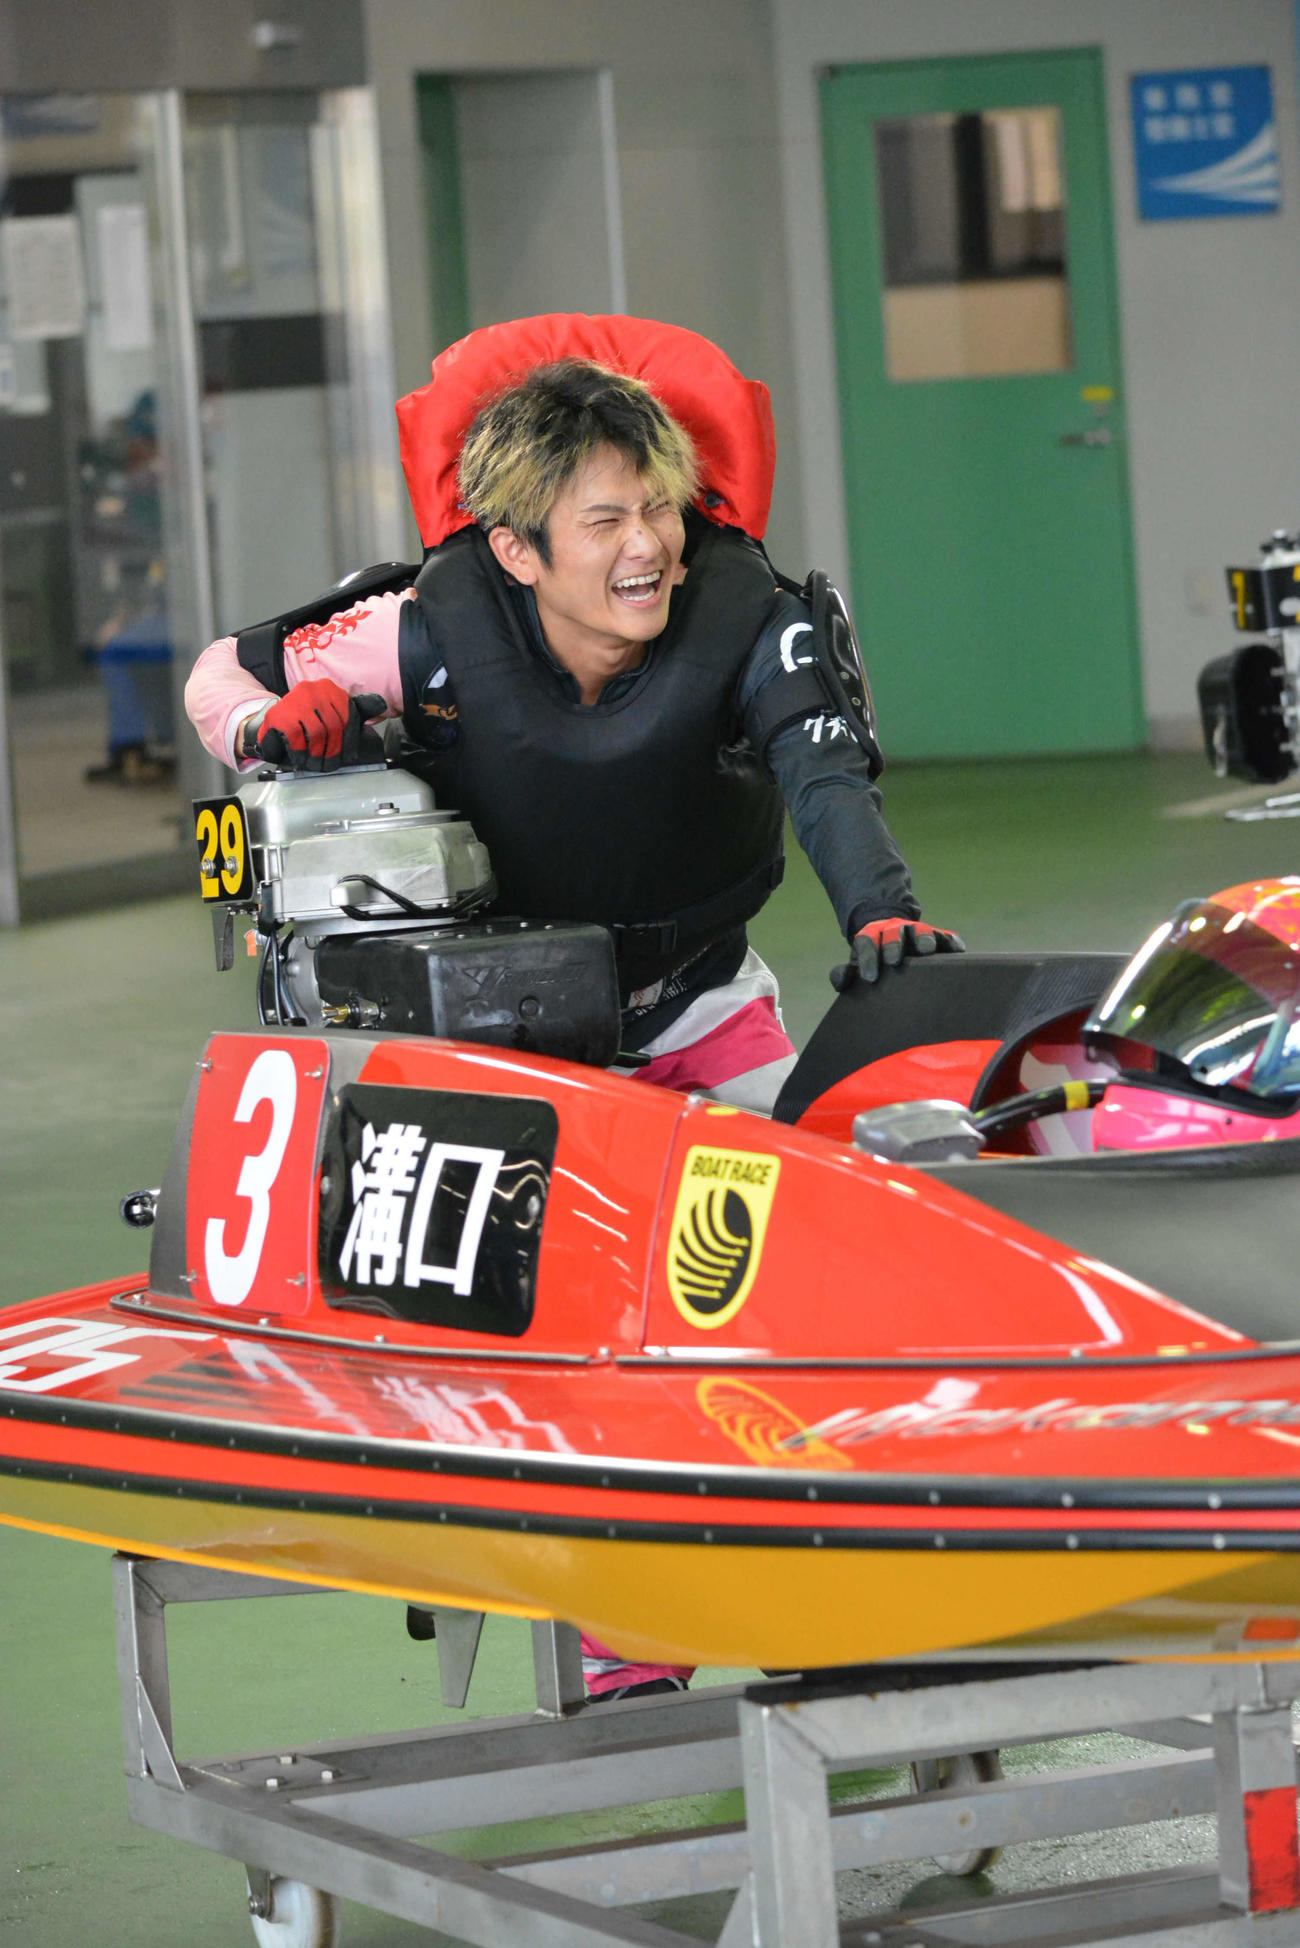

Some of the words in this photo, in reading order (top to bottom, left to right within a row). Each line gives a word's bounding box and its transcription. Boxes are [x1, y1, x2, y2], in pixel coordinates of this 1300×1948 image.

[195, 804, 245, 898] 29
[204, 1050, 297, 1306] 3
[339, 1121, 505, 1296] 溝口
[690, 1154, 731, 1179] BOAT
[728, 1160, 772, 1186] RACE
